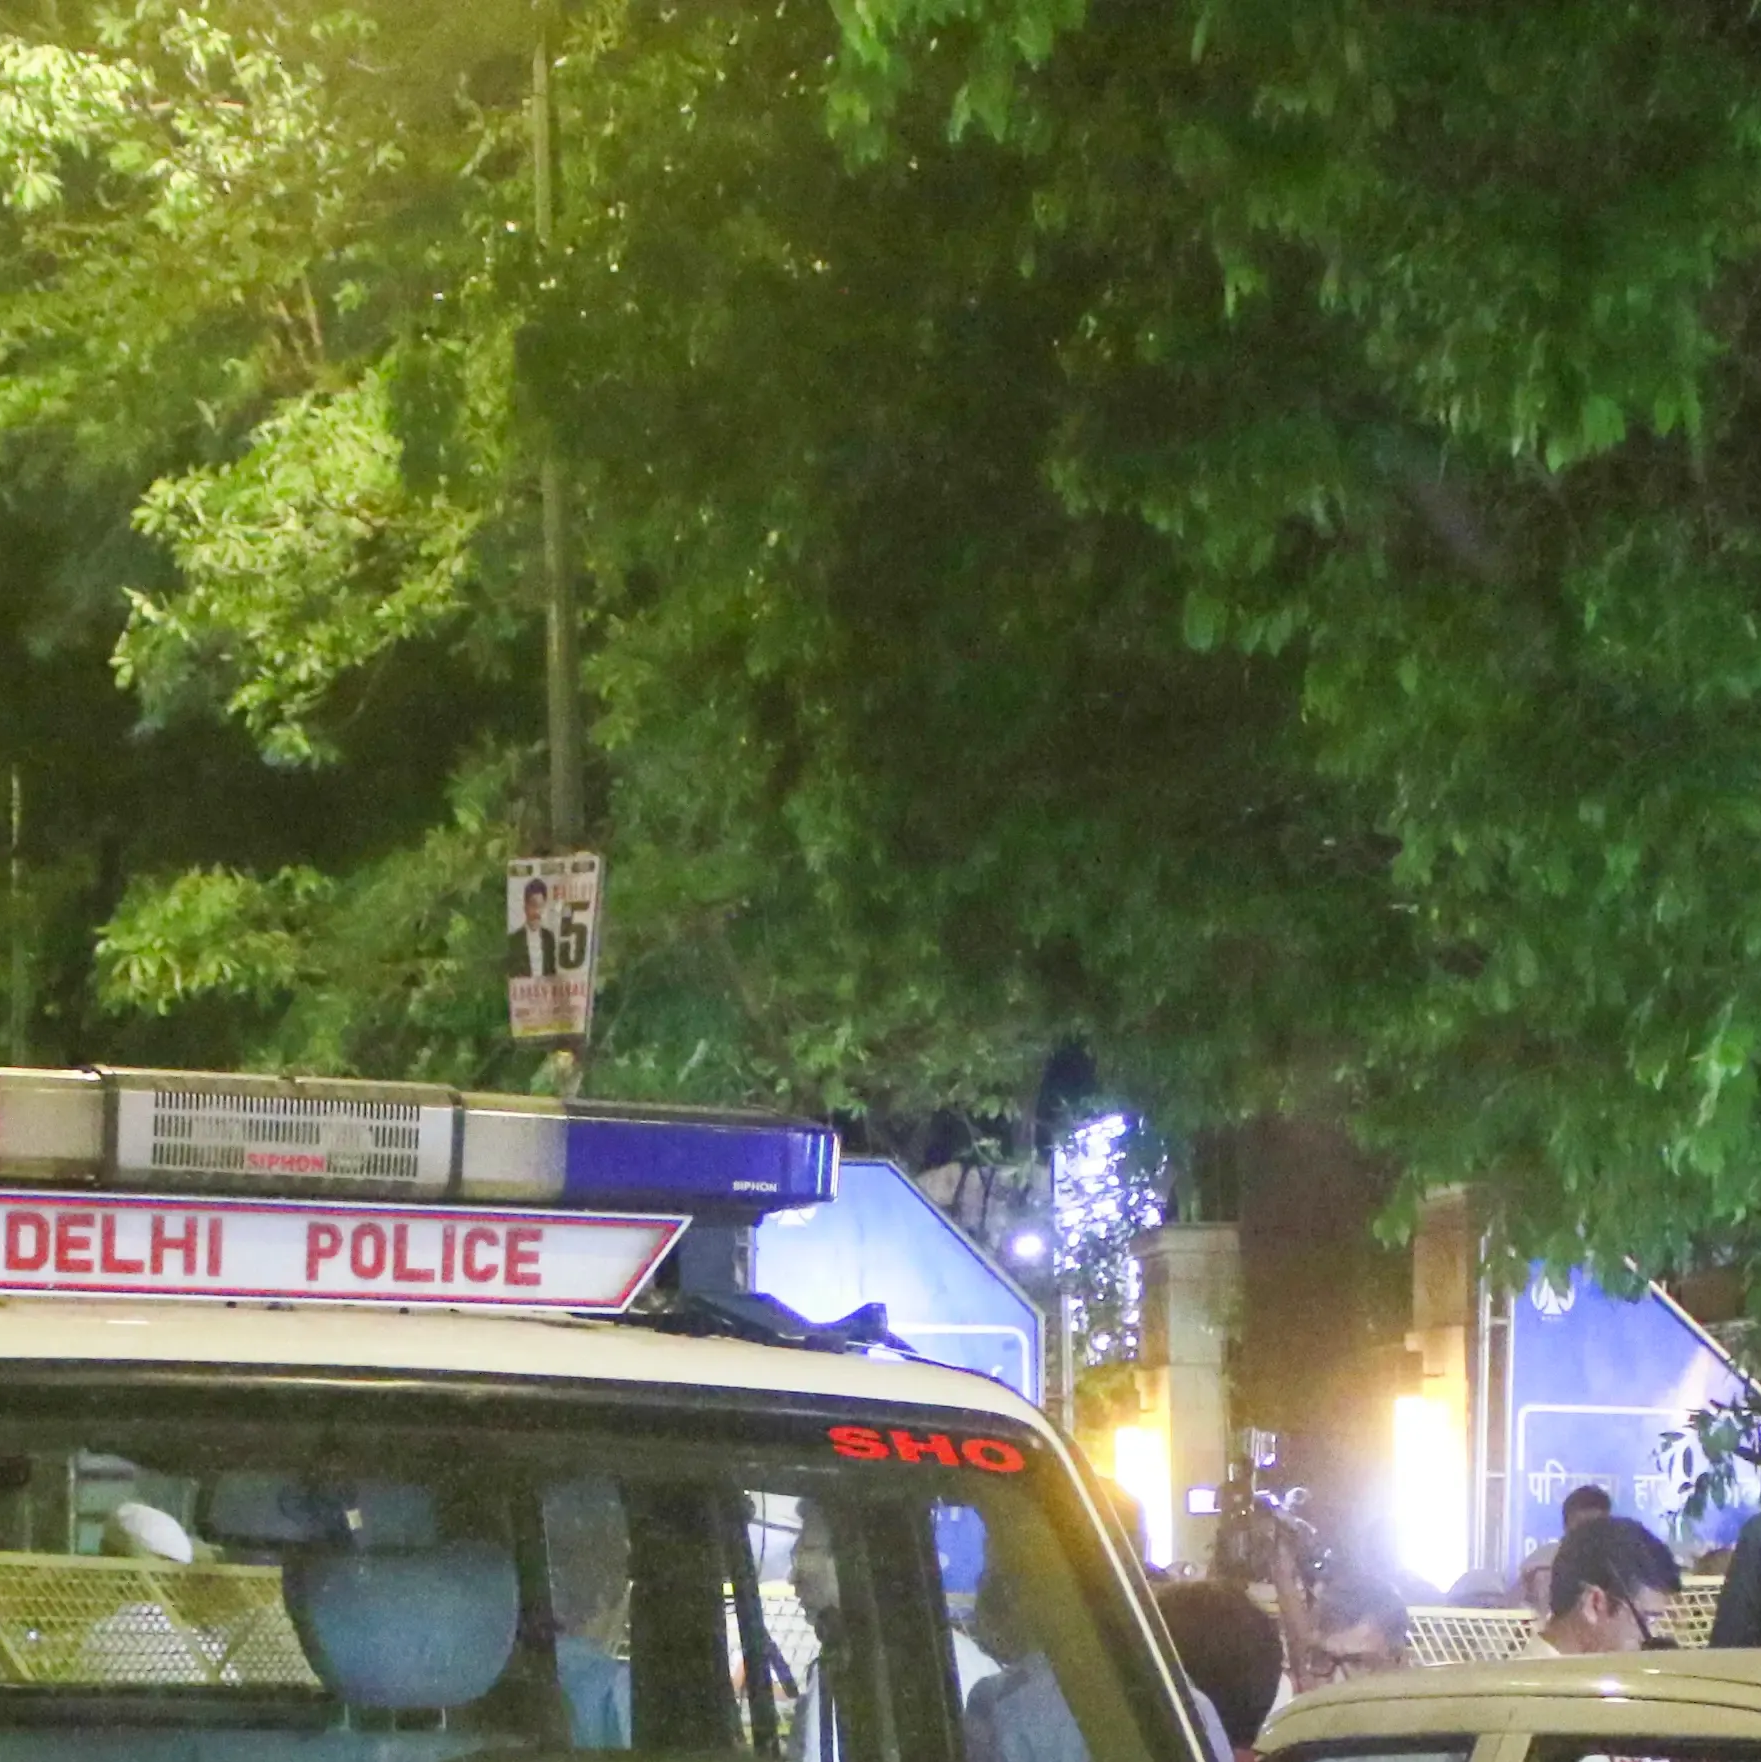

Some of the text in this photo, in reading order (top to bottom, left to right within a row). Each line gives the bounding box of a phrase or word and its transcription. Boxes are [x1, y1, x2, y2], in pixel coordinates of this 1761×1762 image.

[558, 901, 590, 970] 5
[246, 1152, 326, 1174] SIPHON
[732, 1180, 778, 1193] SIPHON
[5, 1209, 543, 1288] DELHI POLICE
[827, 1424, 1026, 1474] SHO
